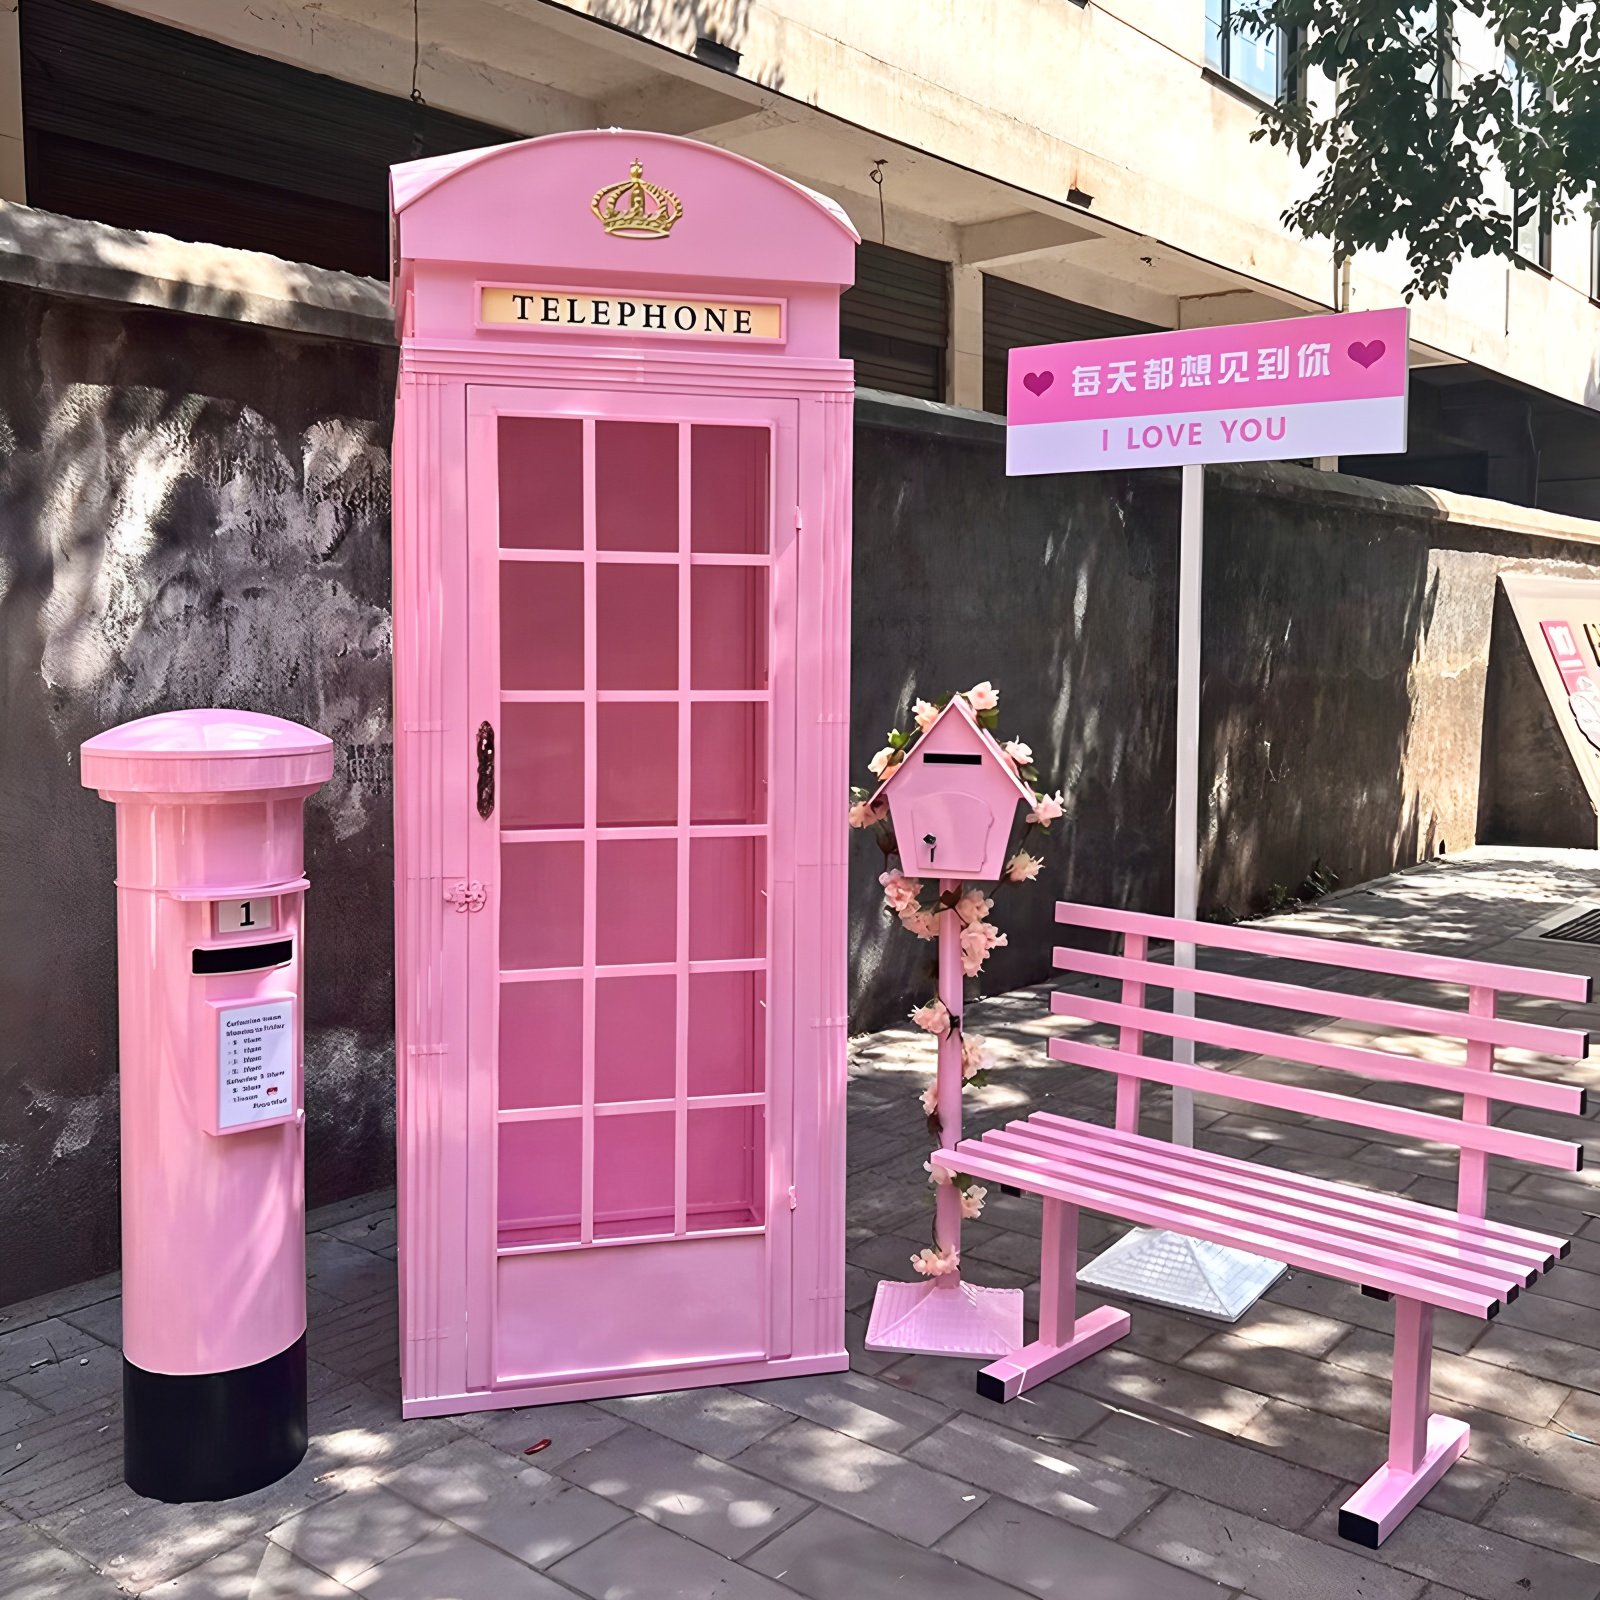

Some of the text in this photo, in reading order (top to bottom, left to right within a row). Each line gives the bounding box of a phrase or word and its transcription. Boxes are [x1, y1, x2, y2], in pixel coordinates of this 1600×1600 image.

[512, 294, 752, 334] TELEPHONE
[1071, 342, 1332, 397] 每天都想见到你
[1102, 416, 1288, 452] I LOVE YOU
[240, 901, 255, 927] 1
